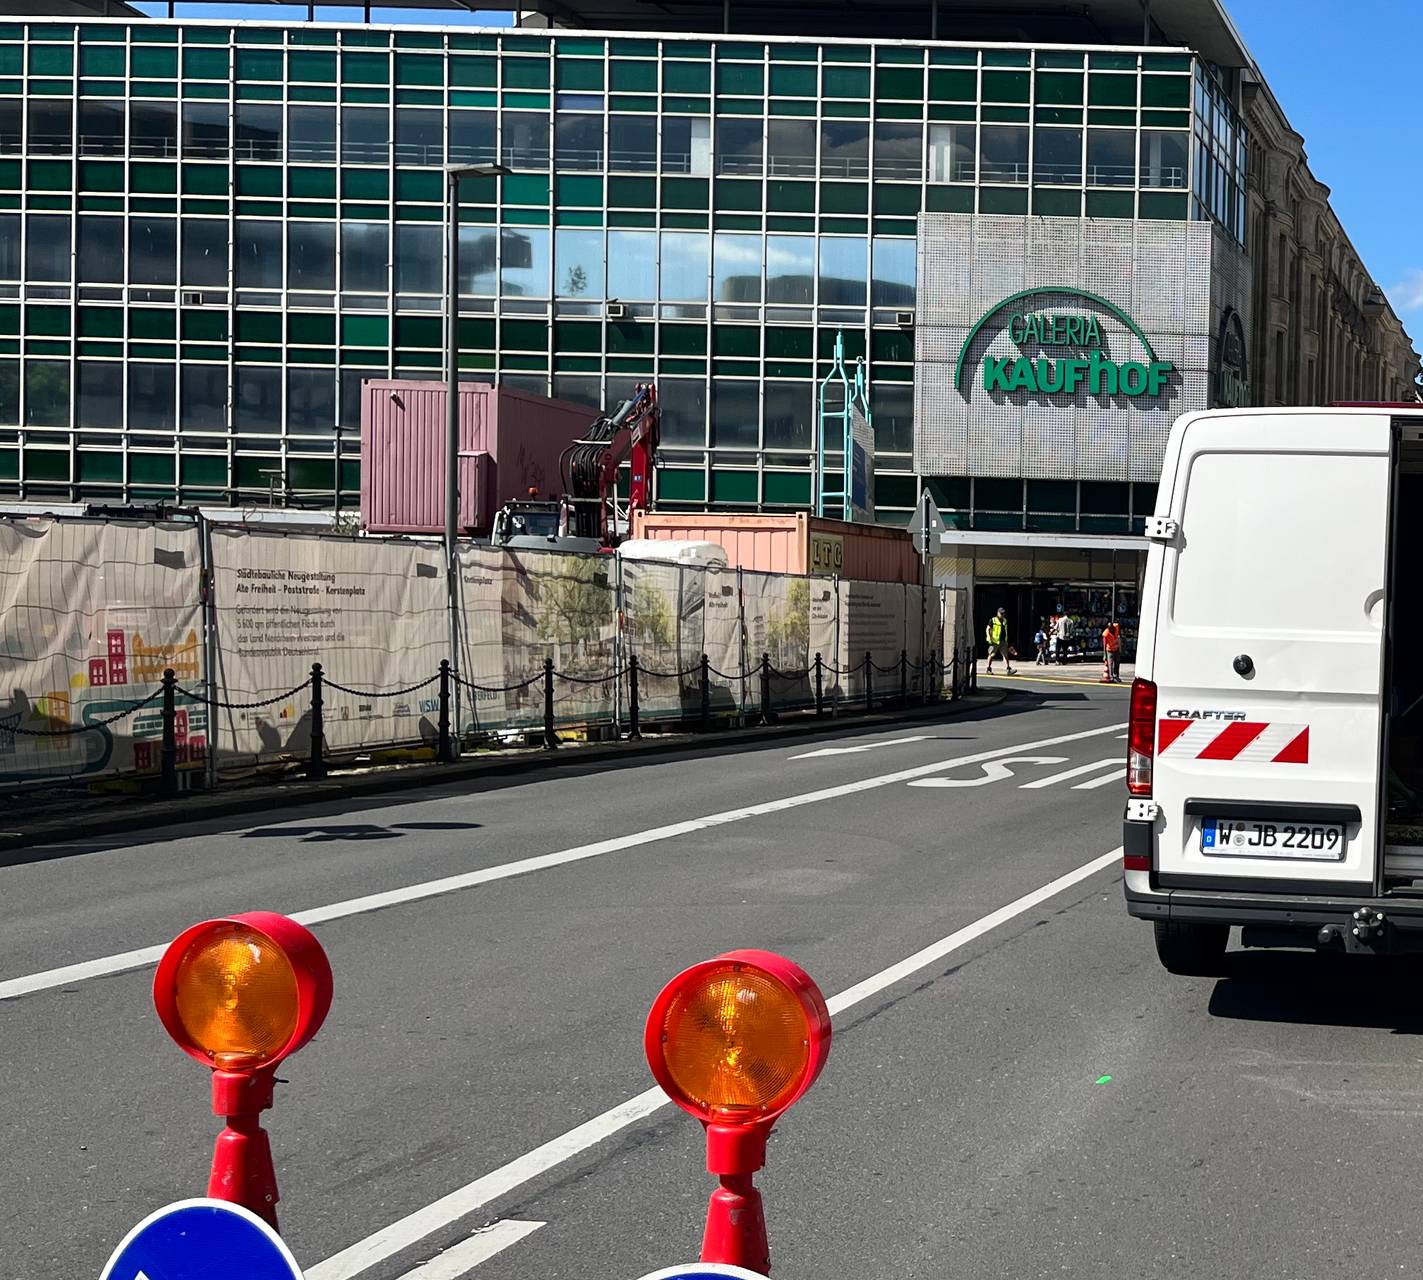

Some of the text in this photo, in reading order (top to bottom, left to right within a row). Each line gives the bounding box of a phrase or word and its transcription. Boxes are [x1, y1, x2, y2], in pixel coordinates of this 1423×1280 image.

[1008, 312, 1101, 346] GALERIA
[1167, 709, 1246, 721] CRAFTER
[1218, 823, 1231, 845] W
[1248, 825, 1277, 847] JB
[1282, 826, 1339, 850] 2209
